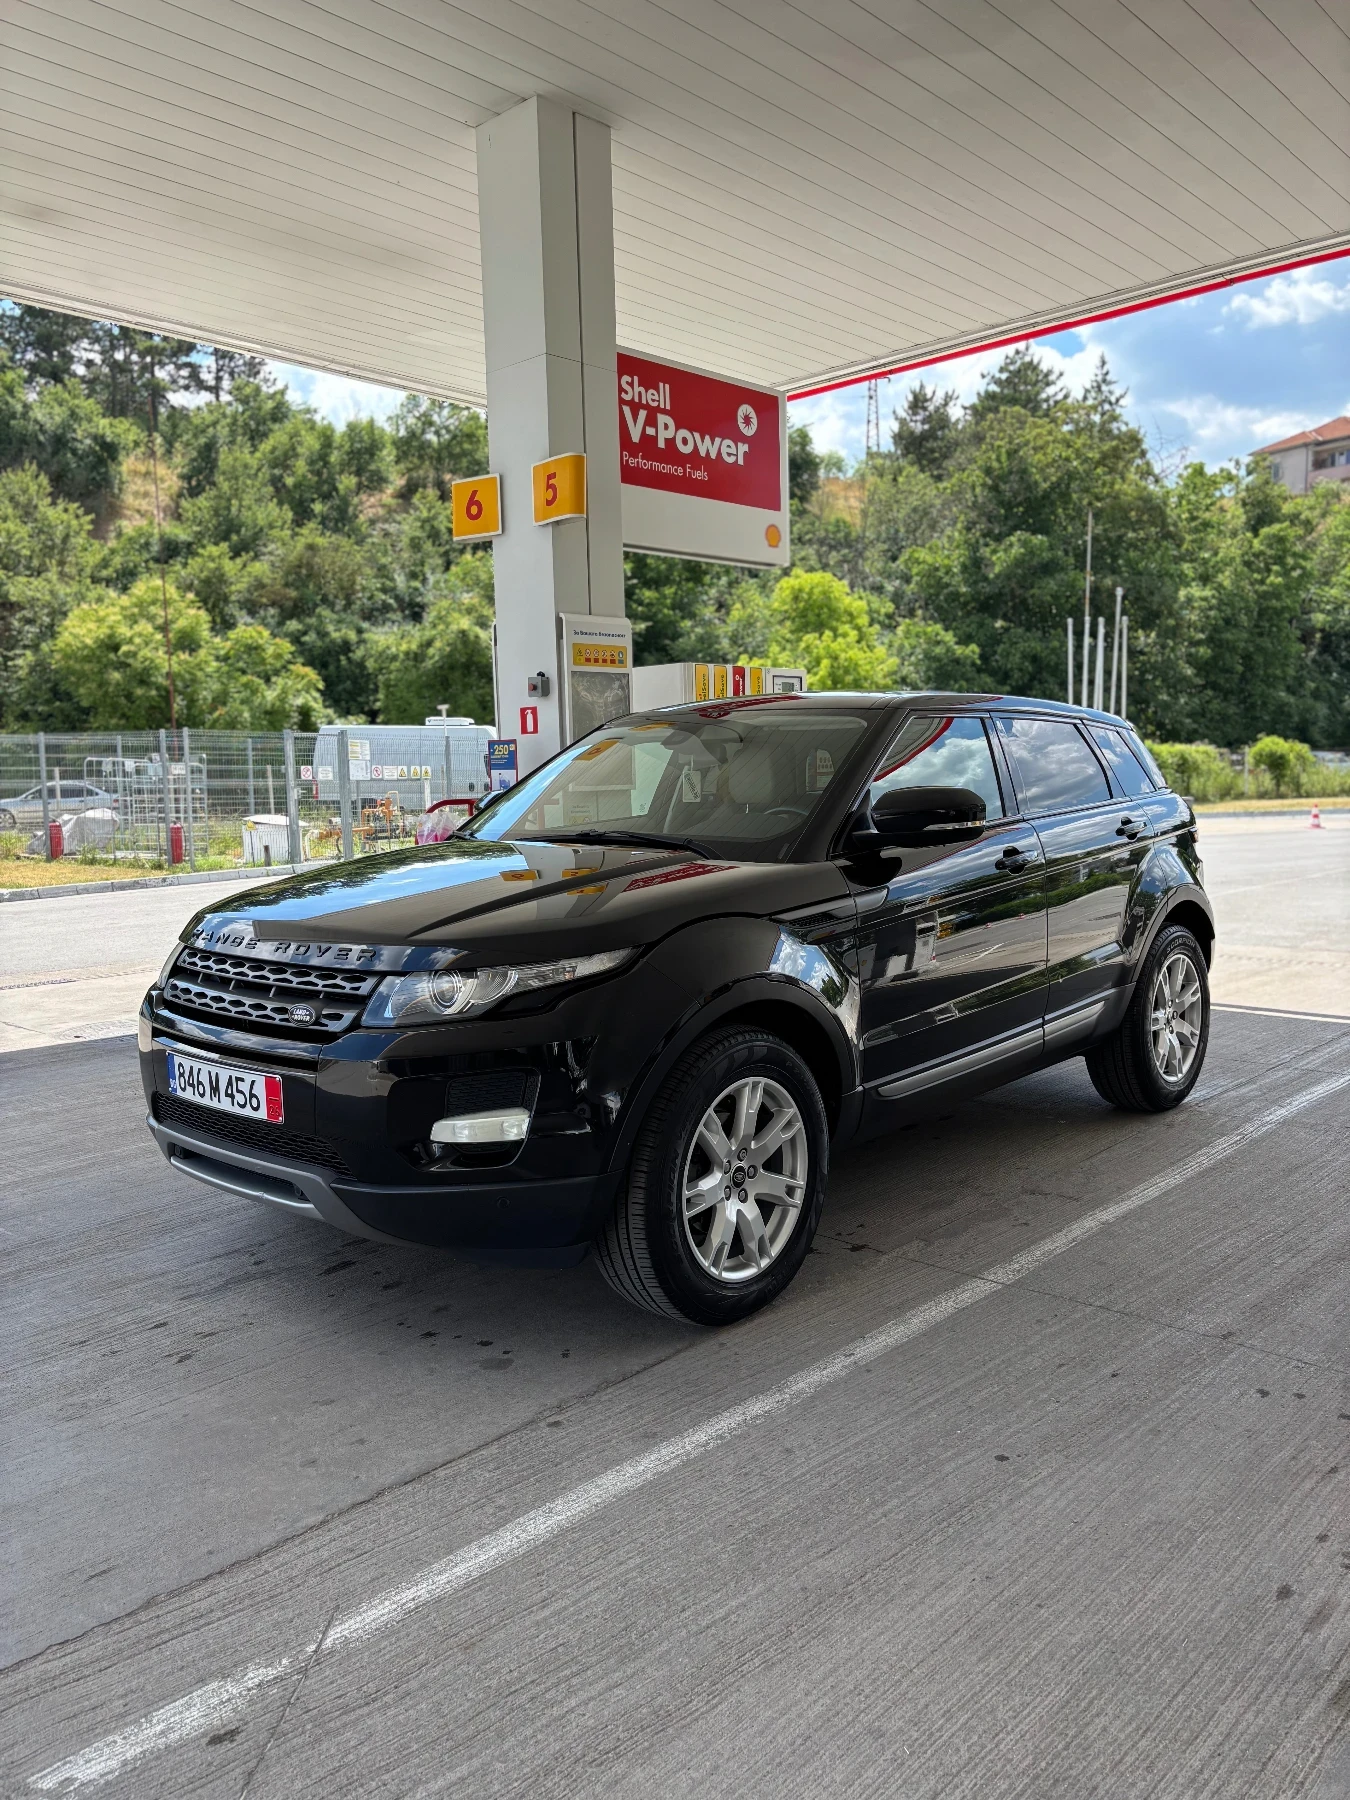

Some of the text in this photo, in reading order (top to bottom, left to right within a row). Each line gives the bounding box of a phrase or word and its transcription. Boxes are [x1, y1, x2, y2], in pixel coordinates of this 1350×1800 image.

[620, 374, 671, 411] Shell
[621, 404, 749, 467] V-Power
[622, 451, 708, 480] Performance Fuels
[465, 489, 484, 521] 6
[545, 471, 558, 507] 5
[192, 927, 377, 962] RANGE ROVER
[177, 1061, 261, 1112] 846 M 456
